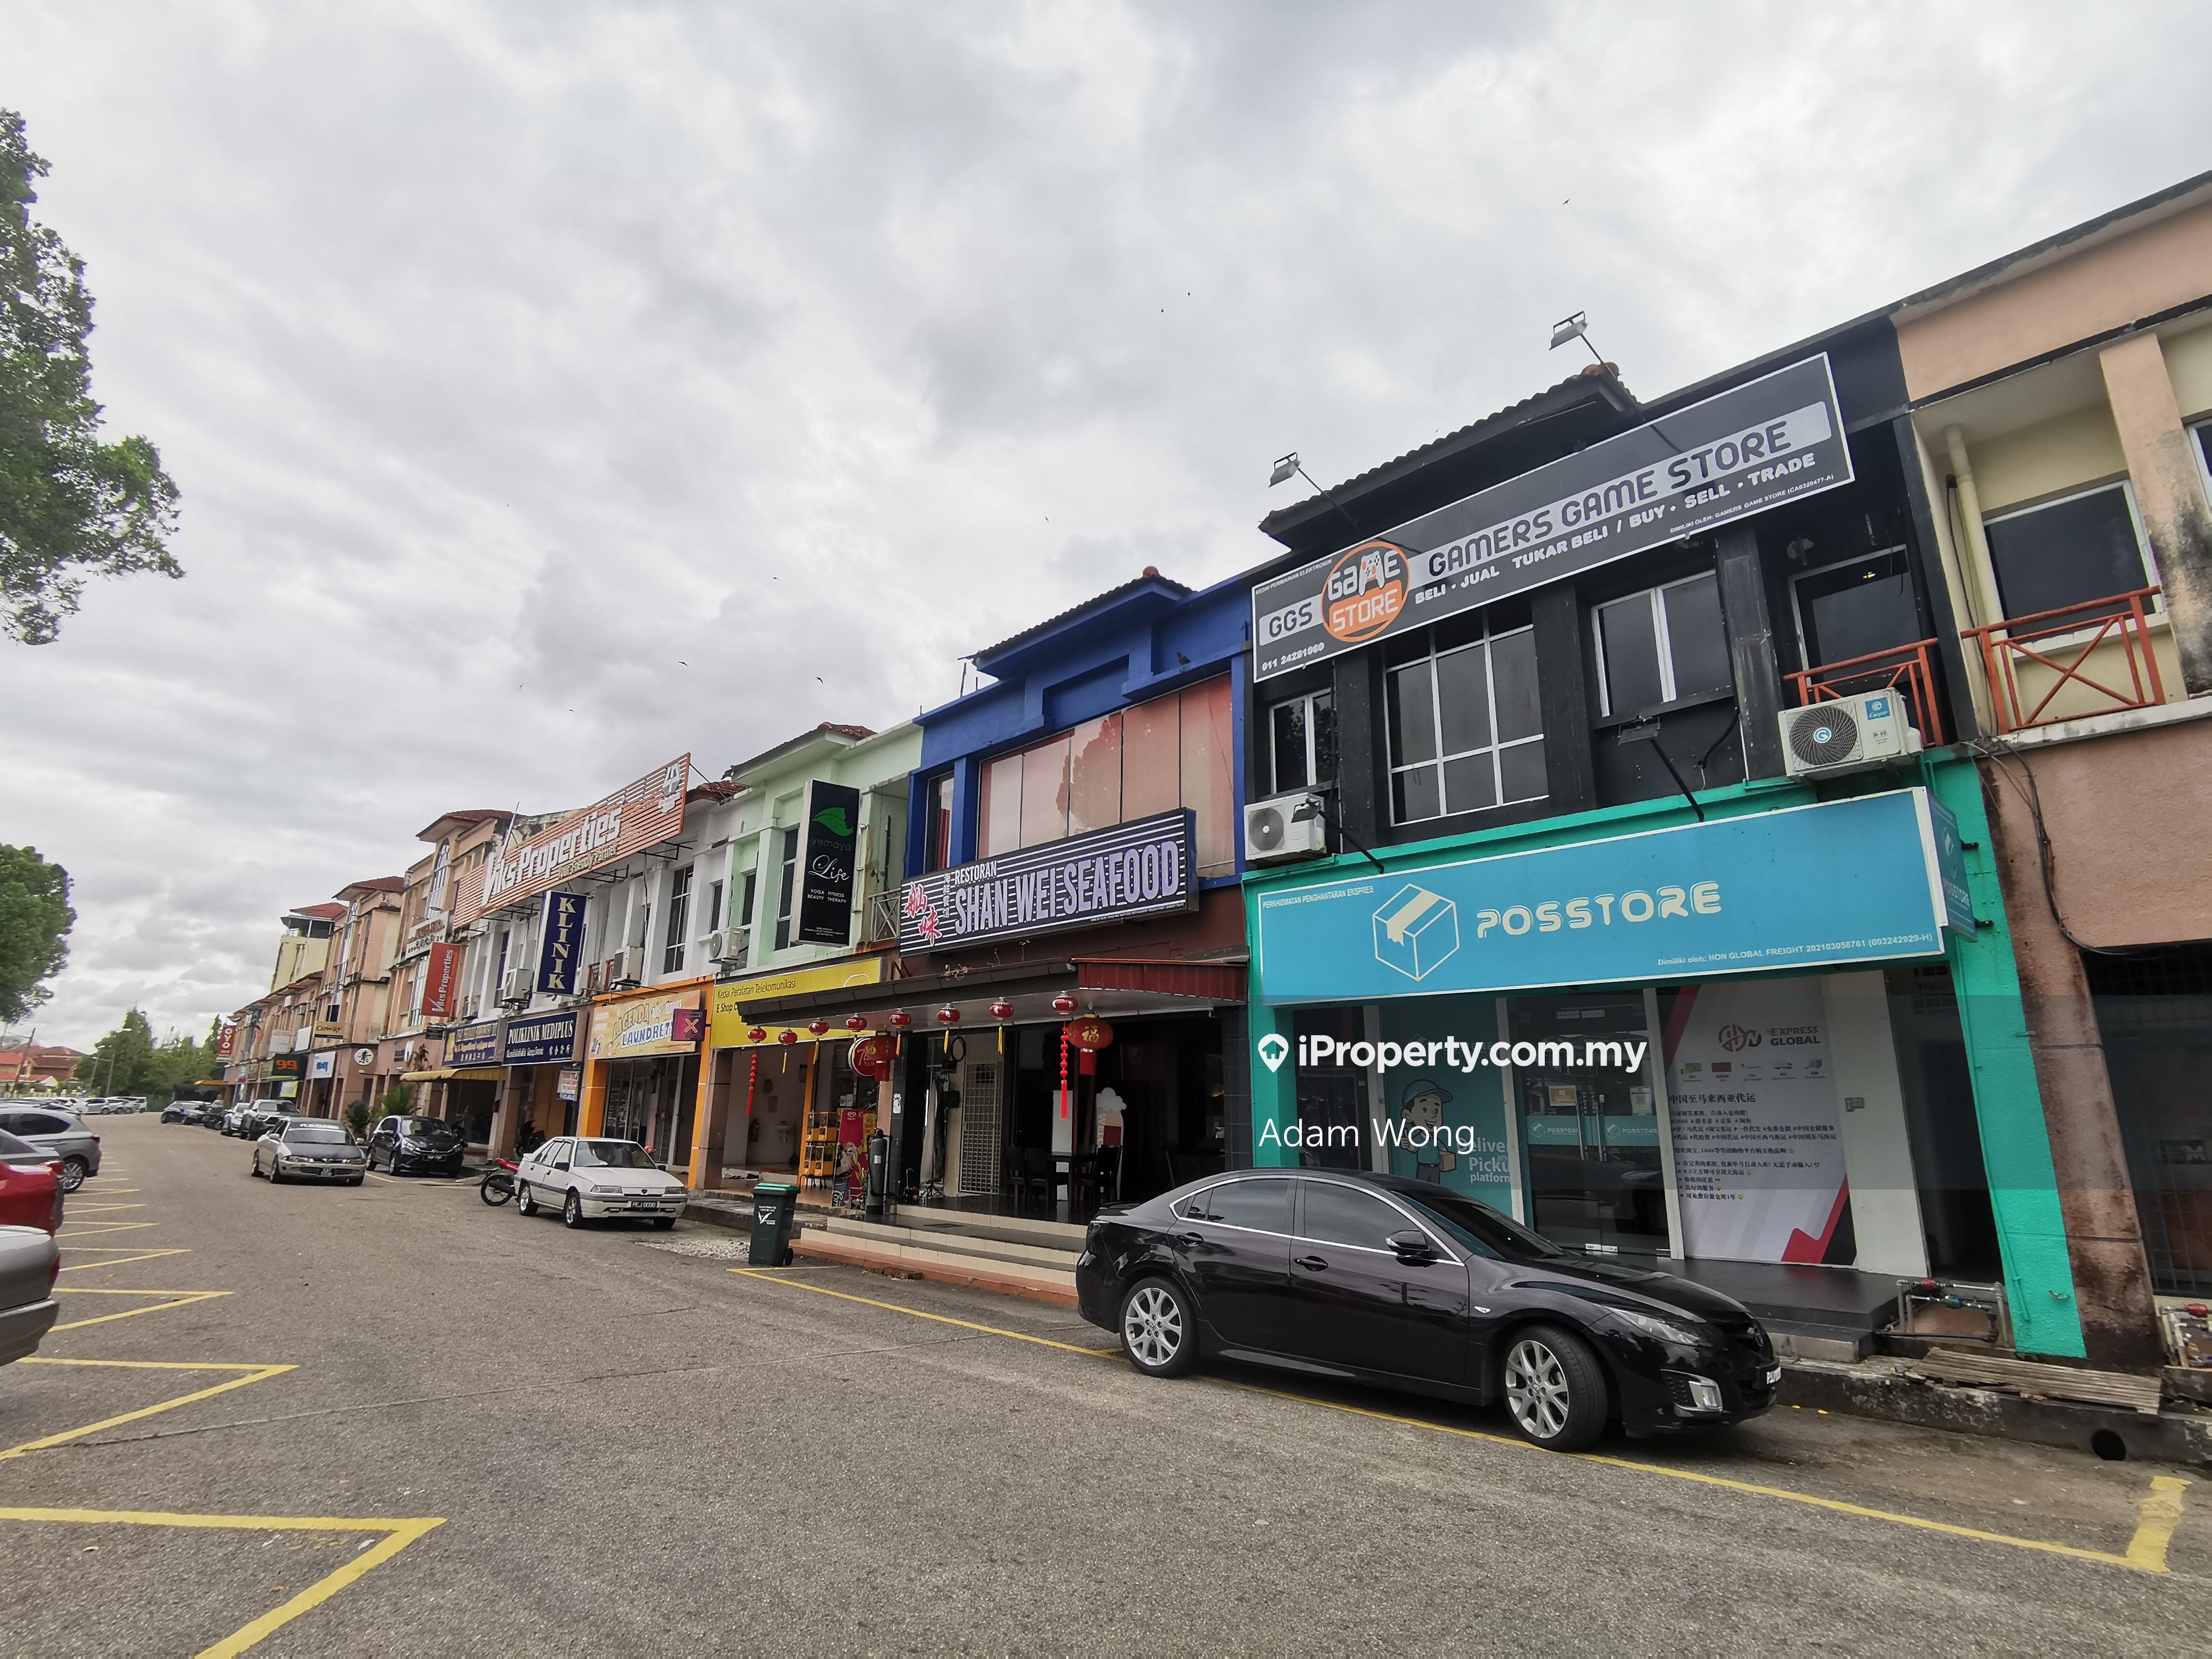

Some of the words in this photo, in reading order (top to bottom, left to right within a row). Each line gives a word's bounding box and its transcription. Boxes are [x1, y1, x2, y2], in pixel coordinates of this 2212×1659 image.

[1427, 508, 1553, 576] GAMERS
[1561, 470, 1658, 527] GAME
[1667, 420, 1792, 490] STORE
[1695, 515, 1714, 526] OLEH:
[1715, 505, 1742, 518] GAMERS
[1743, 497, 1764, 509] GAME
[1764, 489, 1787, 502] STORE
[1415, 587, 1446, 605] BELI
[1460, 565, 1500, 589] JUAL
[1512, 540, 1568, 569] TUKAR
[1572, 525, 1608, 549] BELI
[1629, 504, 1665, 528] BUY
[1684, 483, 1731, 509] SELL
[1747, 453, 1816, 486] TRADE
[1269, 601, 1312, 638] GGS
[1333, 588, 1399, 633] STORE
[1262, 658, 1277, 672] 011
[812, 838, 852, 851] yemaya
[808, 854, 849, 883] Life
[954, 860, 997, 885] RESTORAN
[955, 878, 1008, 935] SHAN
[1015, 866, 1057, 923] WEI
[1063, 841, 1179, 914] SEAFOOD
[1262, 897, 1302, 908] PERKHIDMATAN
[1302, 892, 1346, 902] PENGHANTARAN
[1346, 886, 1373, 896] EKSPRES
[1476, 880, 1722, 938] POSSTORE
[547, 897, 576, 990] KLINIK
[1658, 956, 1686, 966] Dimiliki
[1729, 949, 1764, 959] GLOBAL
[1766, 945, 1804, 956] FREIGHT
[718, 989, 731, 999] Kedai
[731, 986, 754, 997] Peralatan
[755, 978, 796, 993] Telekomunikasi
[613, 1003, 649, 1038] LAGENDA
[716, 1004, 720, 1013] E
[721, 1003, 733, 1013] Shop
[222, 1028, 233, 1048] OYO
[507, 1024, 541, 1044] POLIKLINIK
[541, 1020, 574, 1040] MEDIPLUS
[1766, 1026, 1819, 1036] EXPRESS
[1771, 1036, 1820, 1046] GLOBAL
